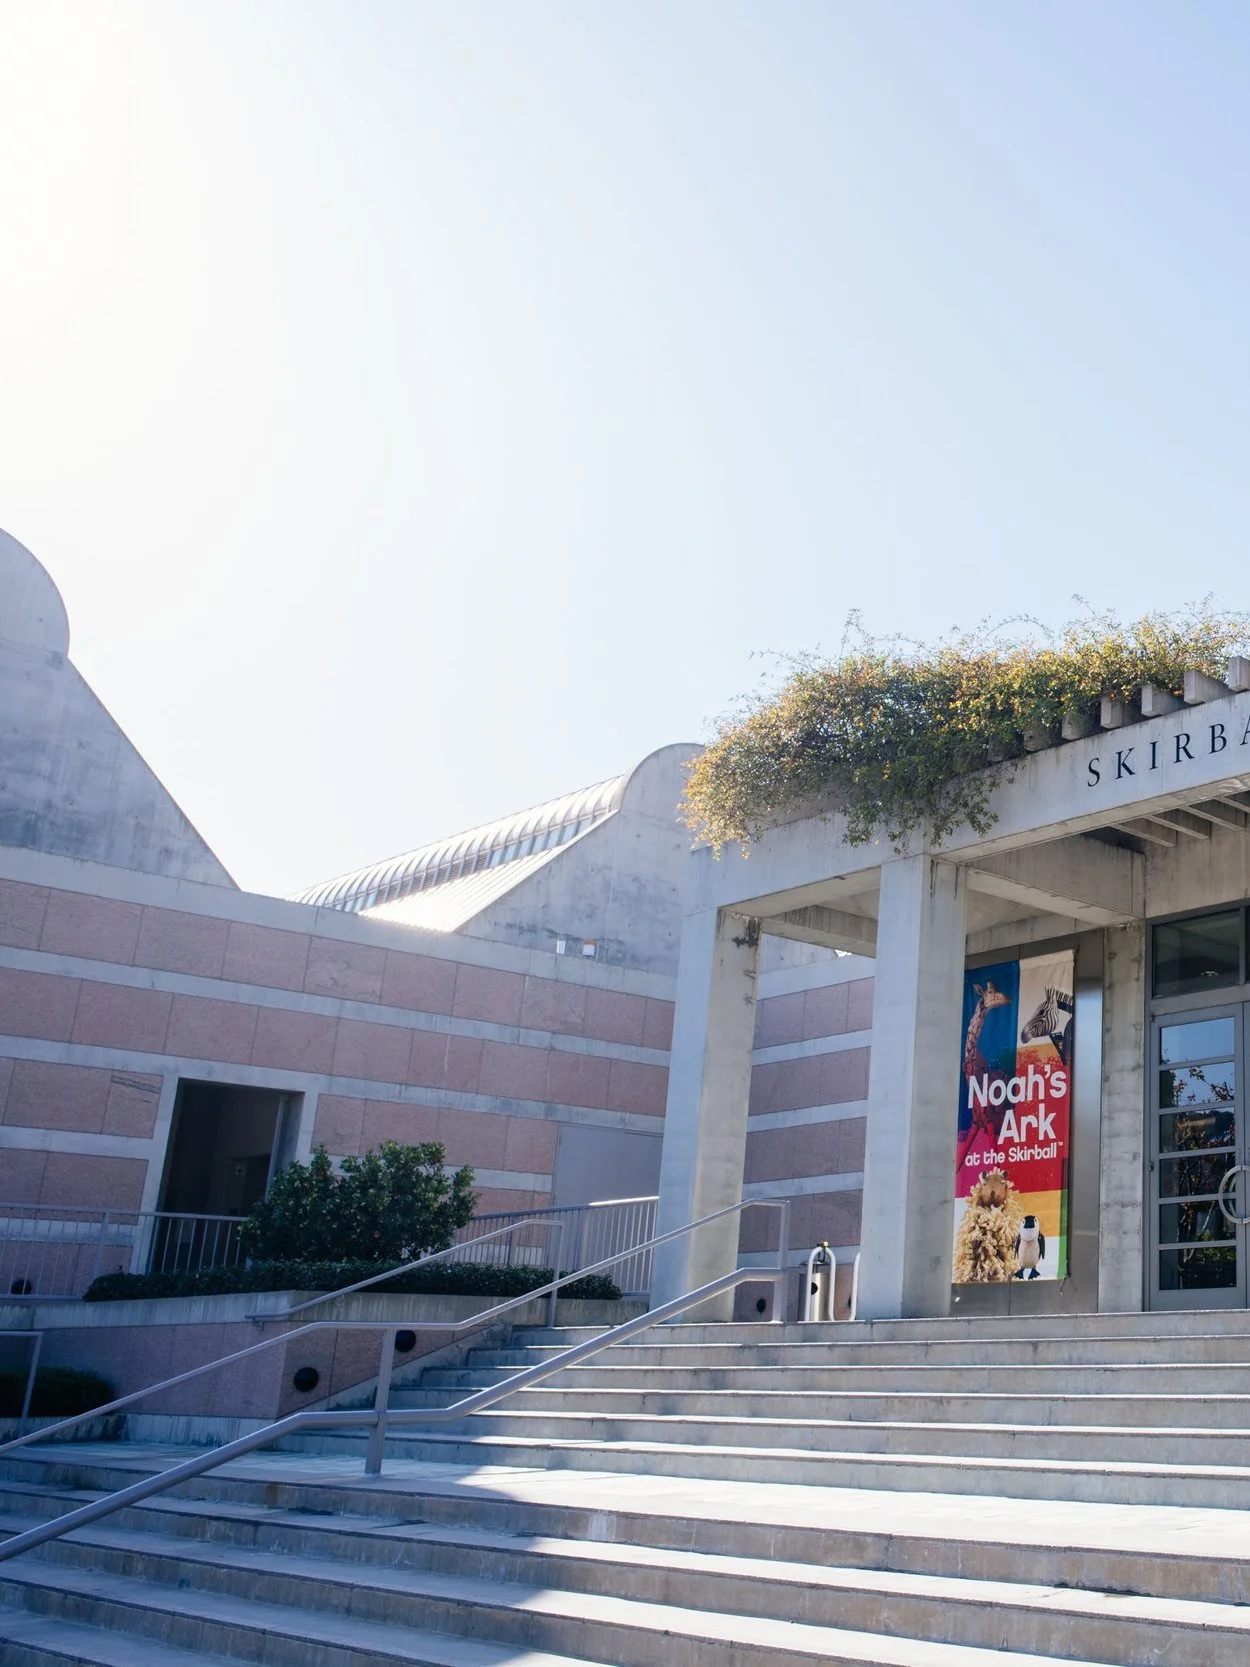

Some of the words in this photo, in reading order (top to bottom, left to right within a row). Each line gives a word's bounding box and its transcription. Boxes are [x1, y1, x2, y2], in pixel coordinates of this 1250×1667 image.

[968, 1064, 1067, 1109] Noah's
[997, 1103, 1057, 1145] Ark
[965, 1152, 980, 1166] at
[983, 1149, 1006, 1165] the
